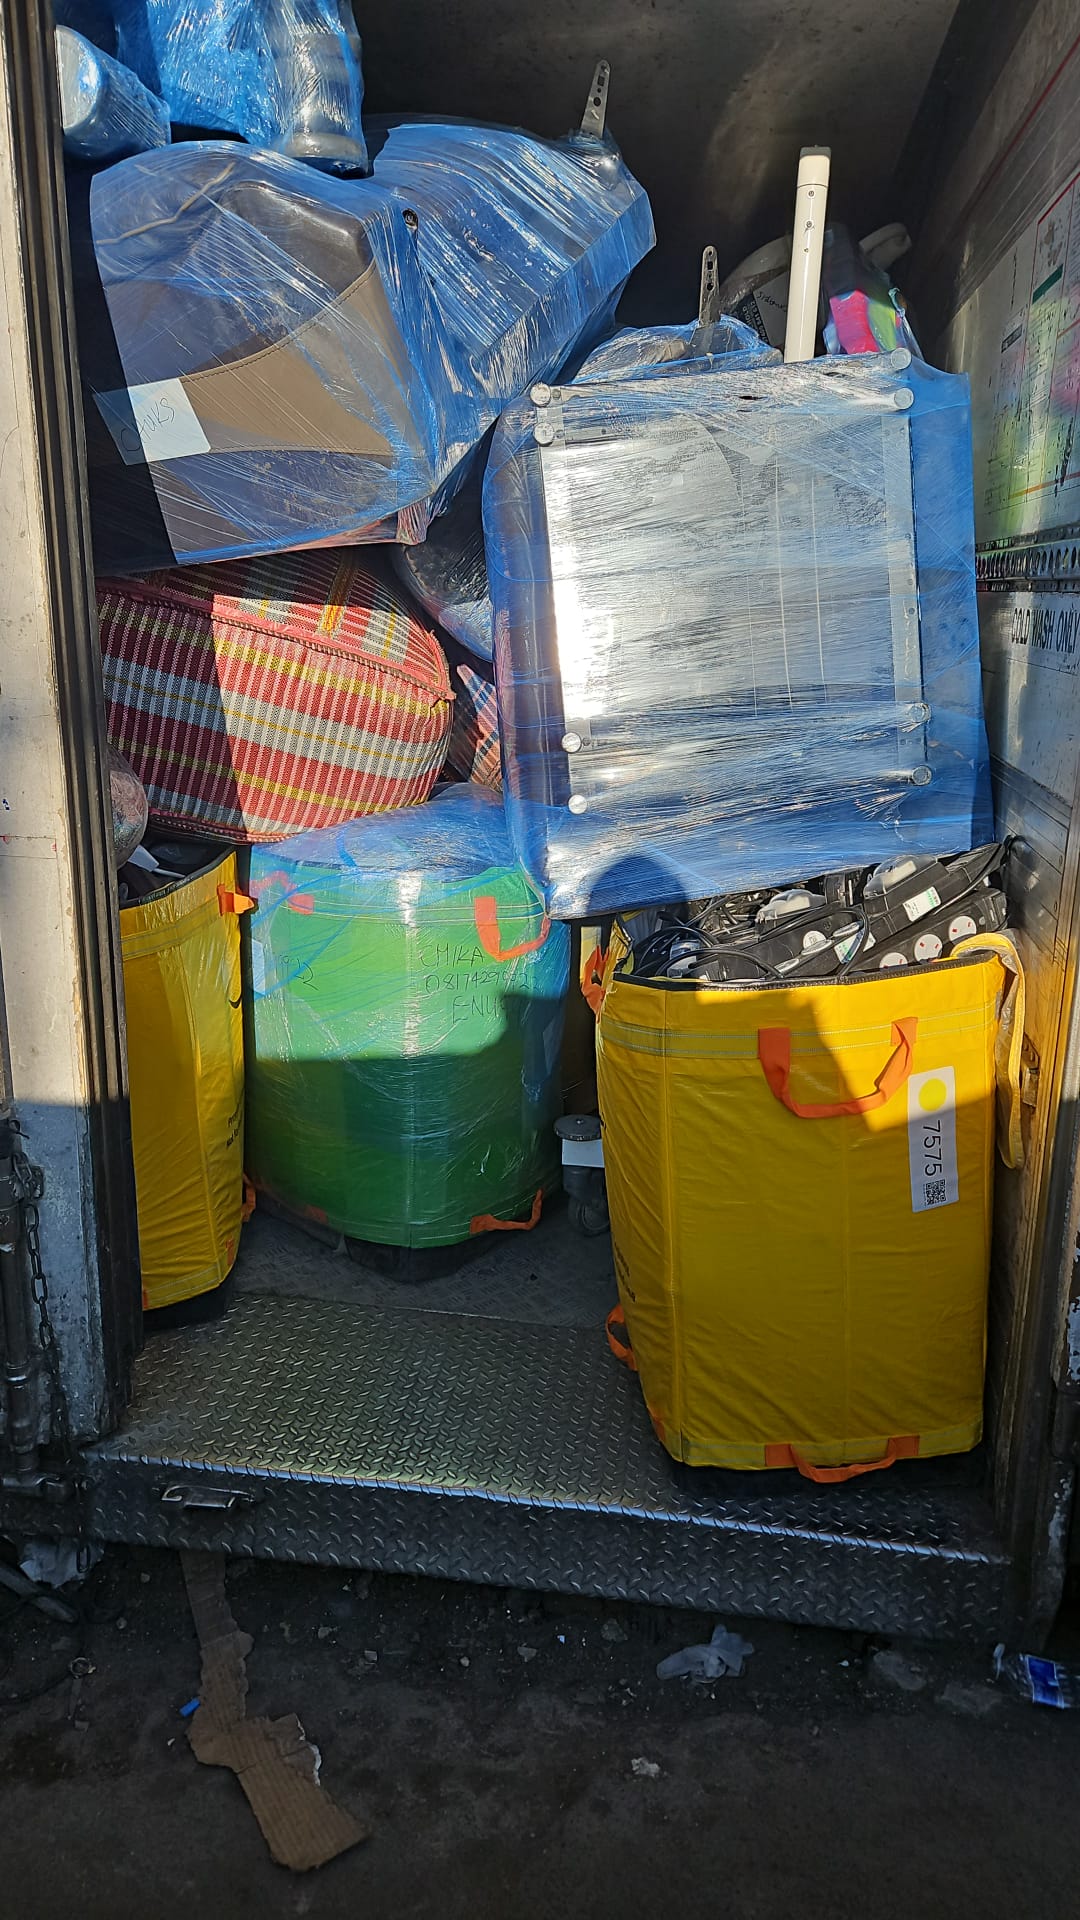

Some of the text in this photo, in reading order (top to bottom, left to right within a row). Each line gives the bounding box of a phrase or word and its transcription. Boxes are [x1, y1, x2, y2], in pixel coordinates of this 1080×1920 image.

[1031, 609, 1056, 650] WASH
[1056, 609, 1080, 654] ONLY
[420, 943, 485, 968] CHIKA
[922, 1119, 943, 1177] 7575
